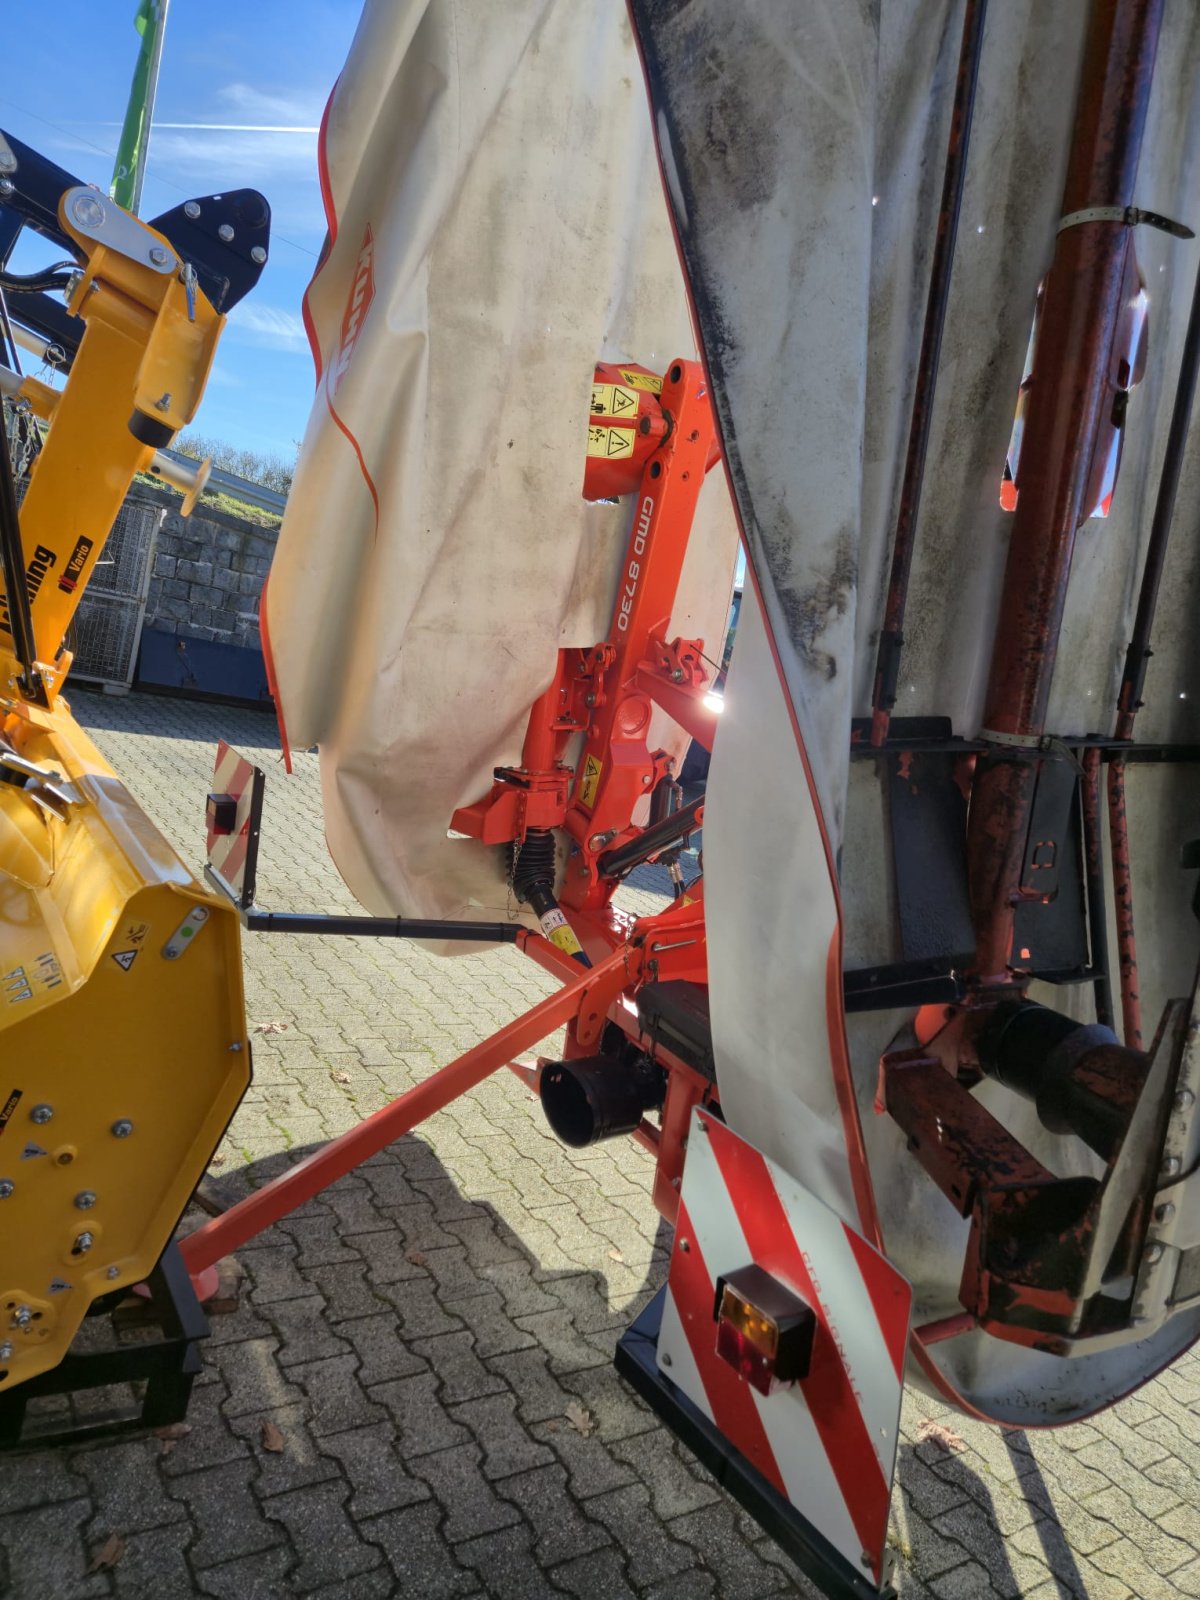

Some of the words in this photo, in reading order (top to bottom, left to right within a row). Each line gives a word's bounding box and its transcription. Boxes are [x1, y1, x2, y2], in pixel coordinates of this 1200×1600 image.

[336, 241, 374, 375] KUHN
[634, 496, 654, 556] GMD
[69, 544, 89, 573] Vario
[617, 560, 640, 632] 8730
[1, 1096, 18, 1122] Vario
